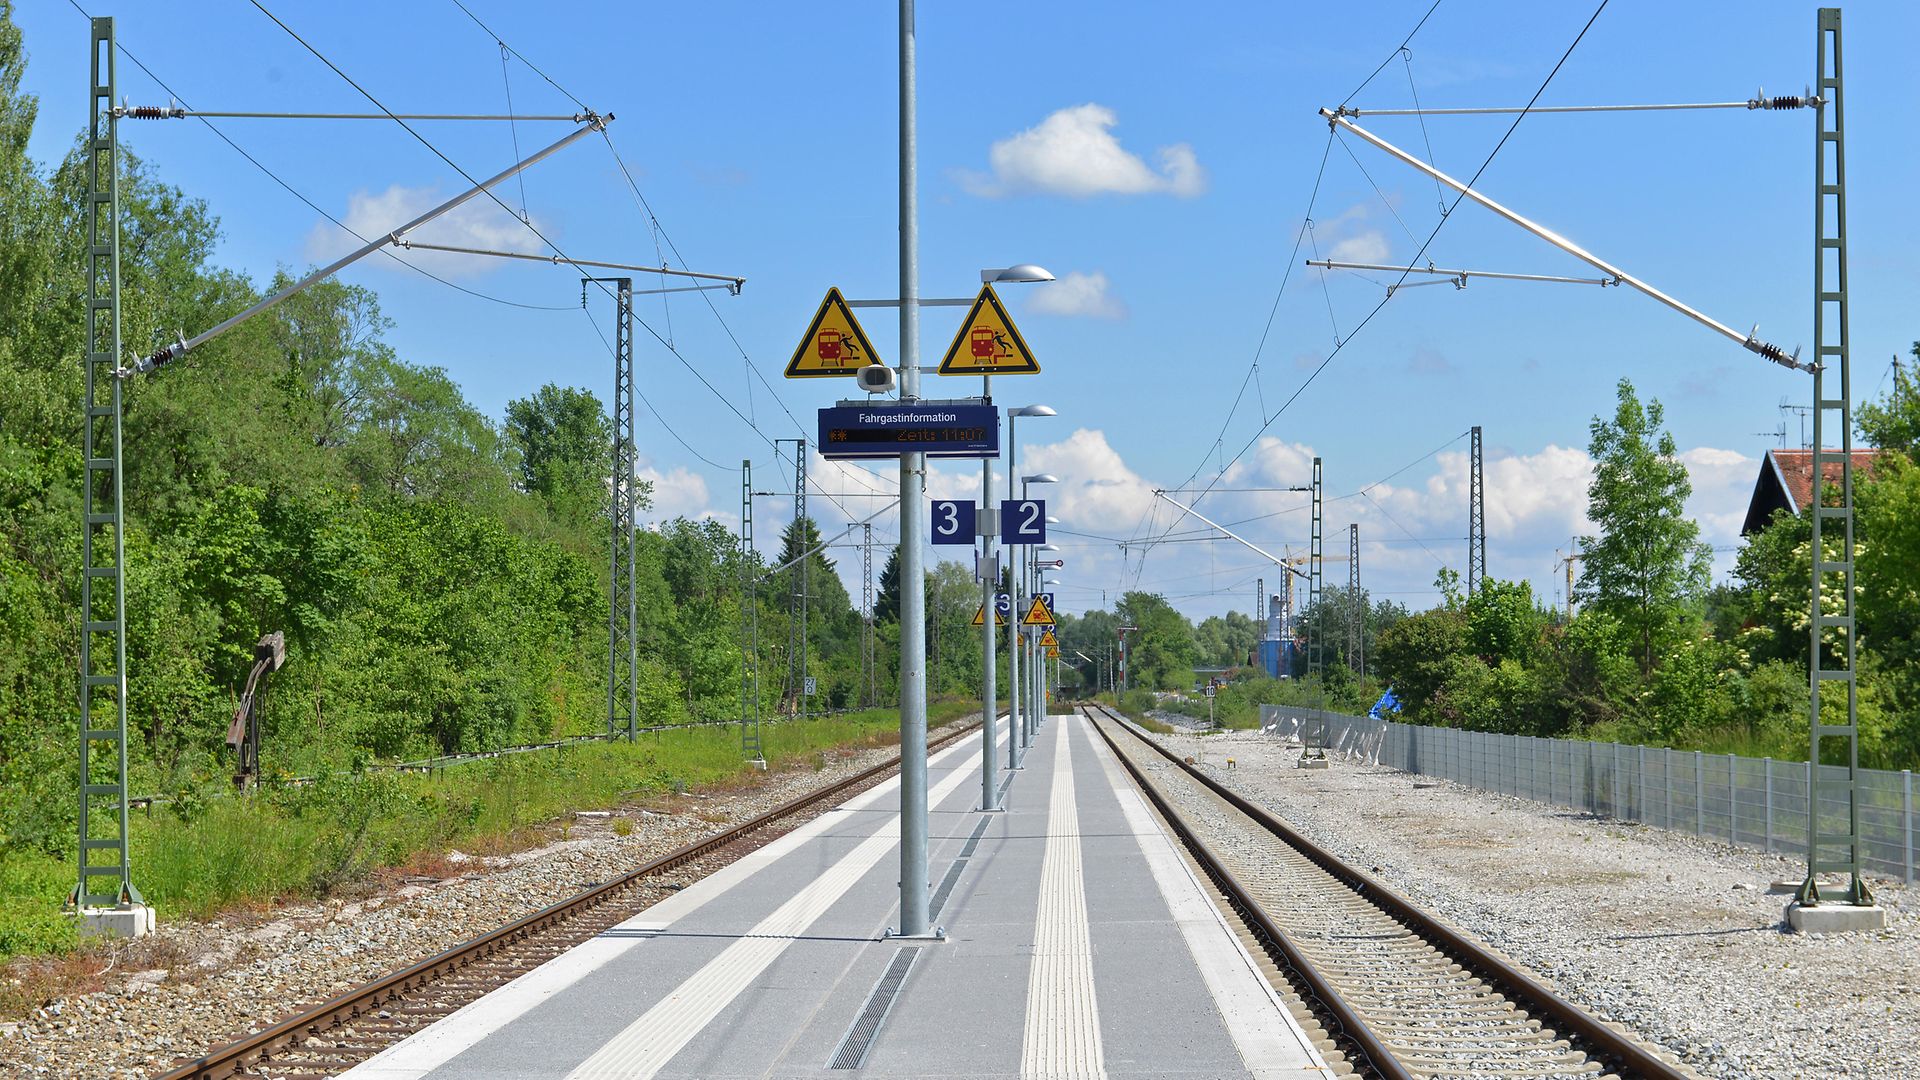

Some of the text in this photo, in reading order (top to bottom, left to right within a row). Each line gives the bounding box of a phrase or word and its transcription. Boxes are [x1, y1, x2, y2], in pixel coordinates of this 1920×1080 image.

[859, 413, 956, 425] Fahrgastinformation
[897, 428, 936, 441] Zeit:
[942, 428, 984, 441] 11:07
[937, 501, 959, 535] 3
[1018, 501, 1040, 534] 2
[1000, 594, 1010, 611] 3
[1207, 687, 1215, 695] 10
